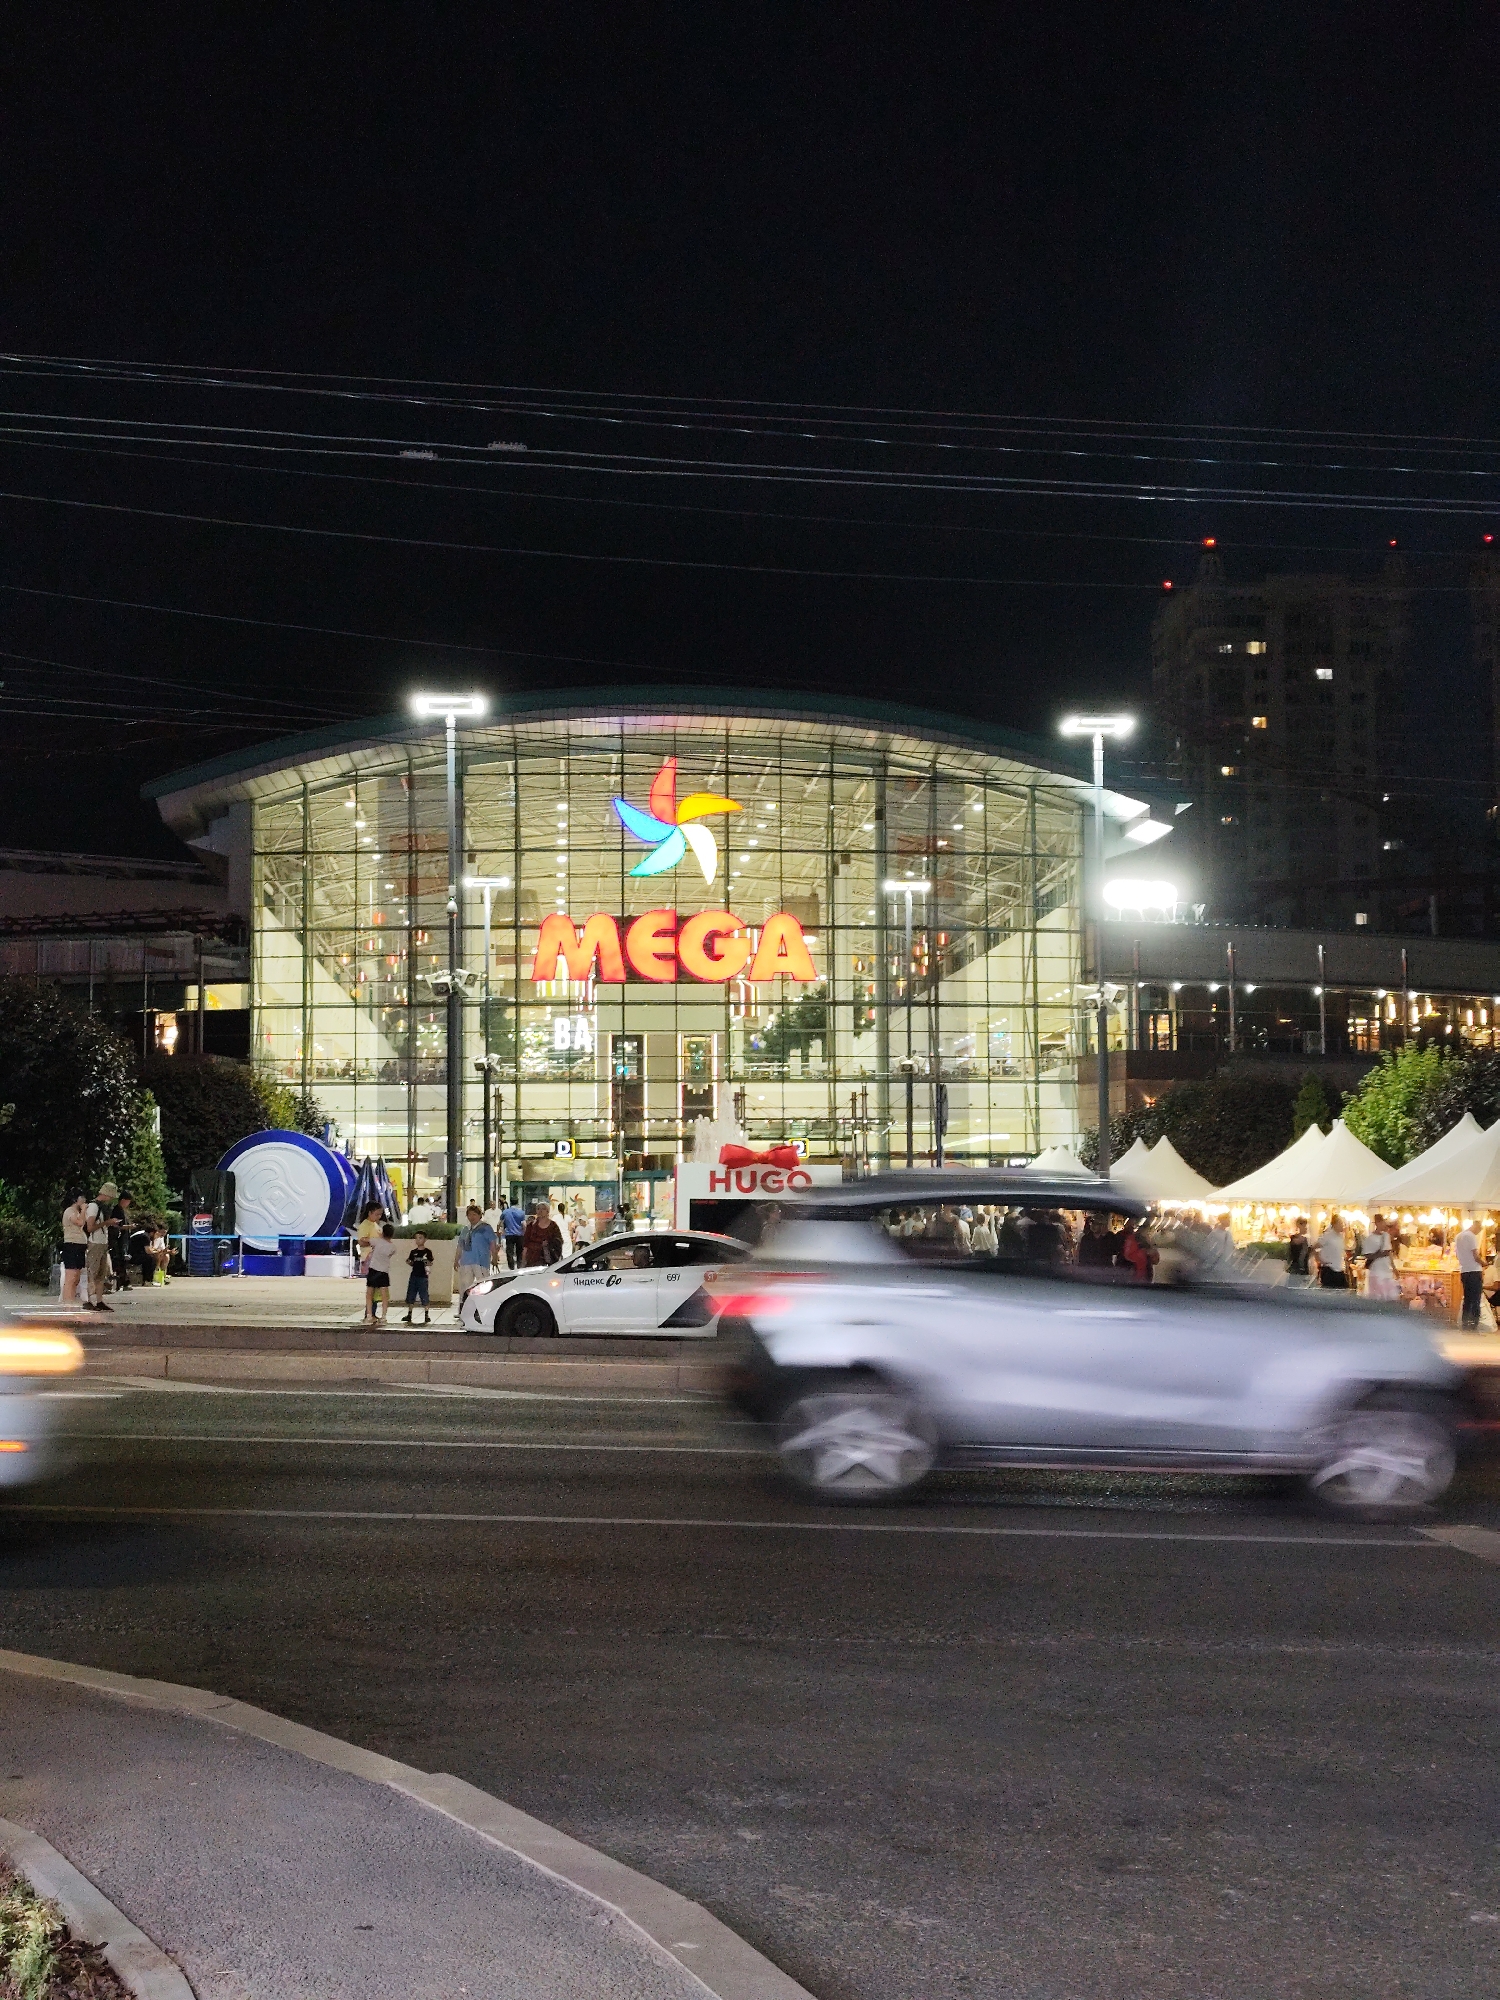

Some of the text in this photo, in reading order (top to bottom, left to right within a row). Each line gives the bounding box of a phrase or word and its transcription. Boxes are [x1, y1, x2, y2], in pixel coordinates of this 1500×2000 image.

[531, 909, 818, 982] MEGA
[709, 1170, 813, 1194] HUGO
[573, 1274, 622, 1288] Яндекс Go
[666, 1273, 681, 1282] 697
